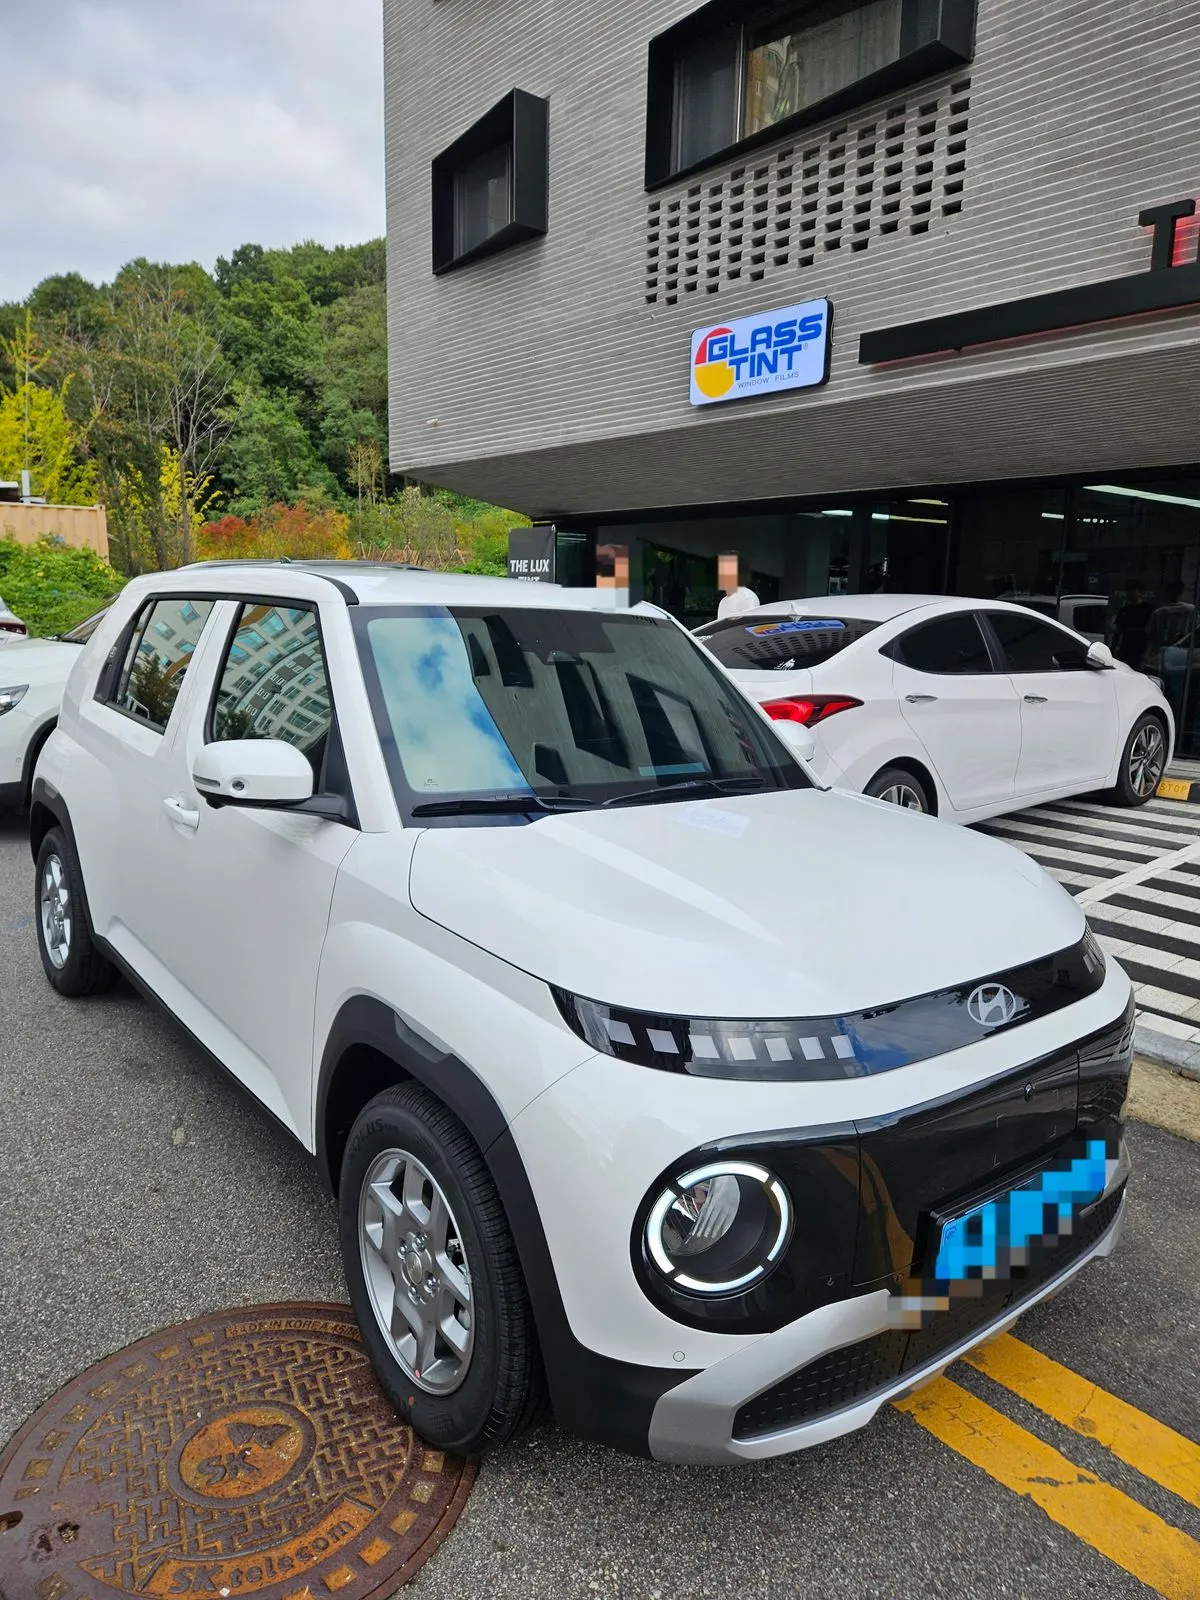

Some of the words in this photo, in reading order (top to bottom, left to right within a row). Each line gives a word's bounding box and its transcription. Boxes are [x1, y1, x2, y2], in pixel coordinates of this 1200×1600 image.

[1138, 199, 1200, 272] T
[707, 312, 823, 362] GLASS
[728, 344, 802, 381] TINT
[738, 377, 769, 389] WINDOW
[775, 371, 799, 382] FILMS
[510, 559, 529, 573] THE
[530, 559, 550, 573] LUX
[1160, 782, 1188, 793] STOP
[269, 1319, 282, 1329] IN
[285, 1319, 328, 1331] KOREA
[197, 1447, 260, 1487] SK
[167, 1564, 223, 1595] SK
[229, 1520, 355, 1588] telecom
